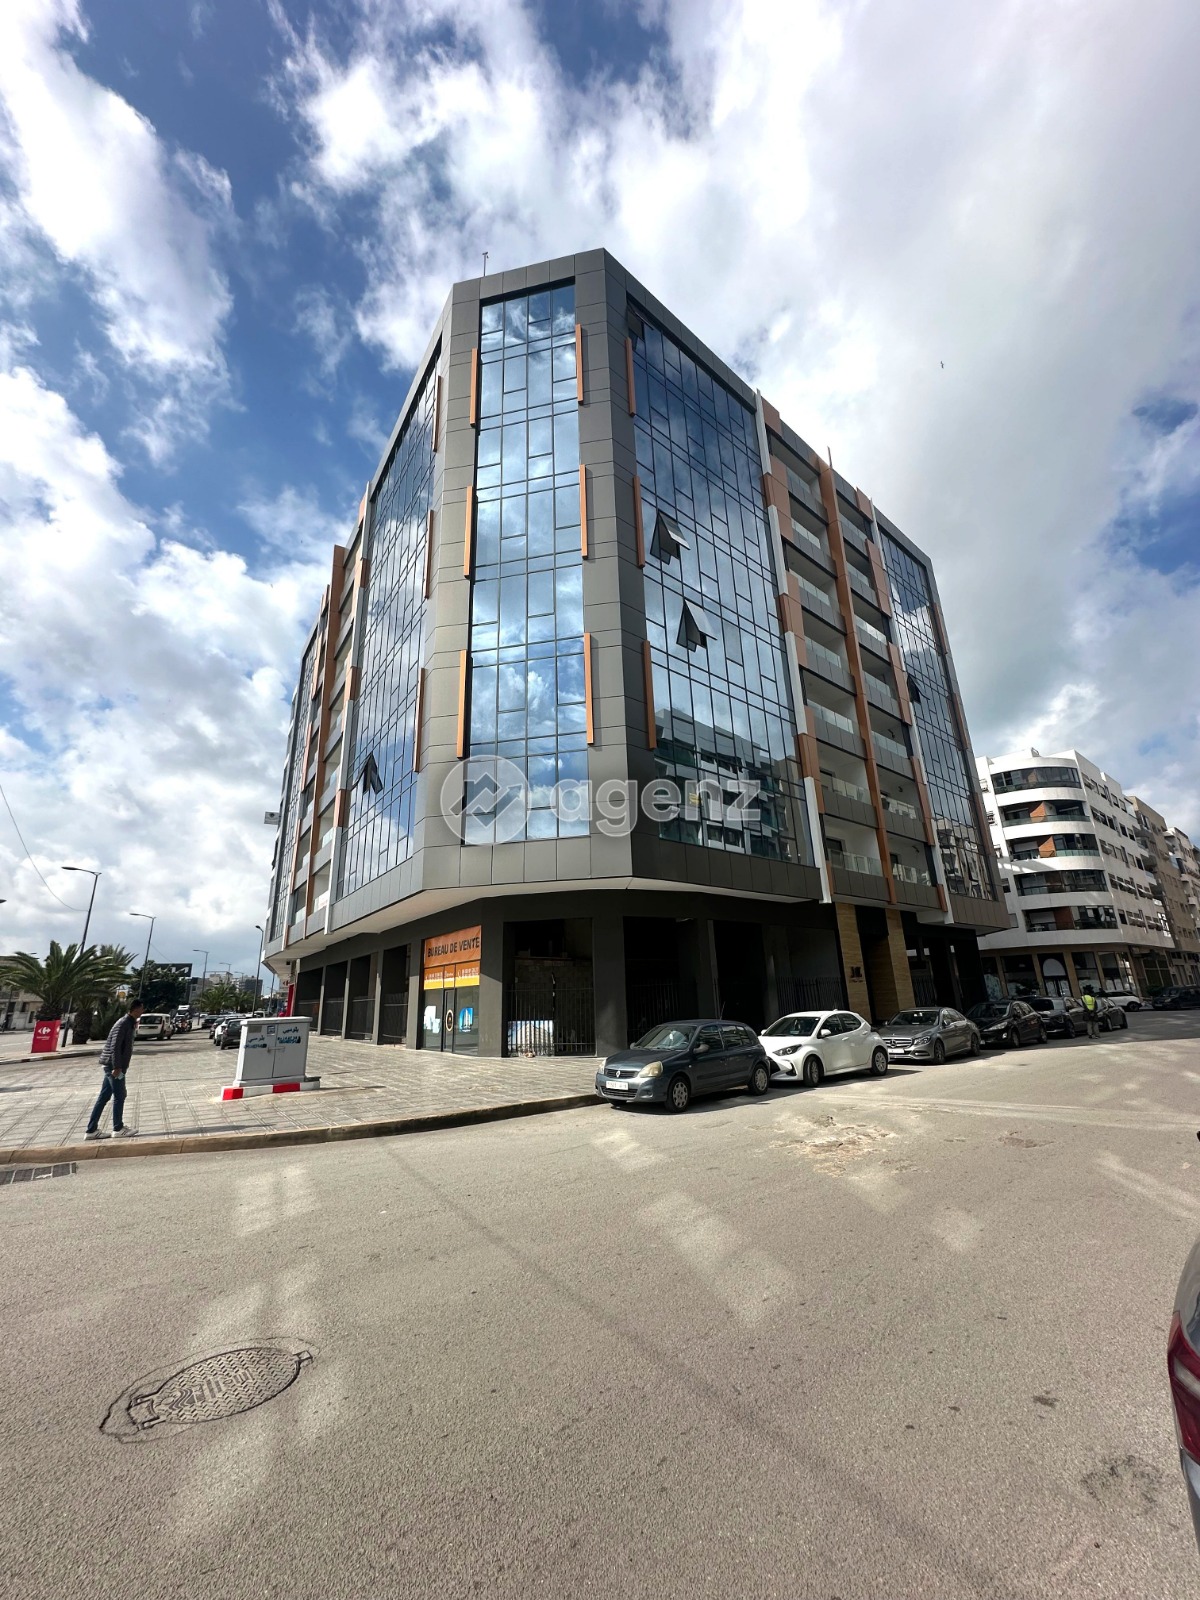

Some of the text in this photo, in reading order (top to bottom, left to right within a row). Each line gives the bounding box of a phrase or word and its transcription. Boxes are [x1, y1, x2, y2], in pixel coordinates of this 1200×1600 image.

[427, 937, 480, 957] BUREAU DE VENTE
